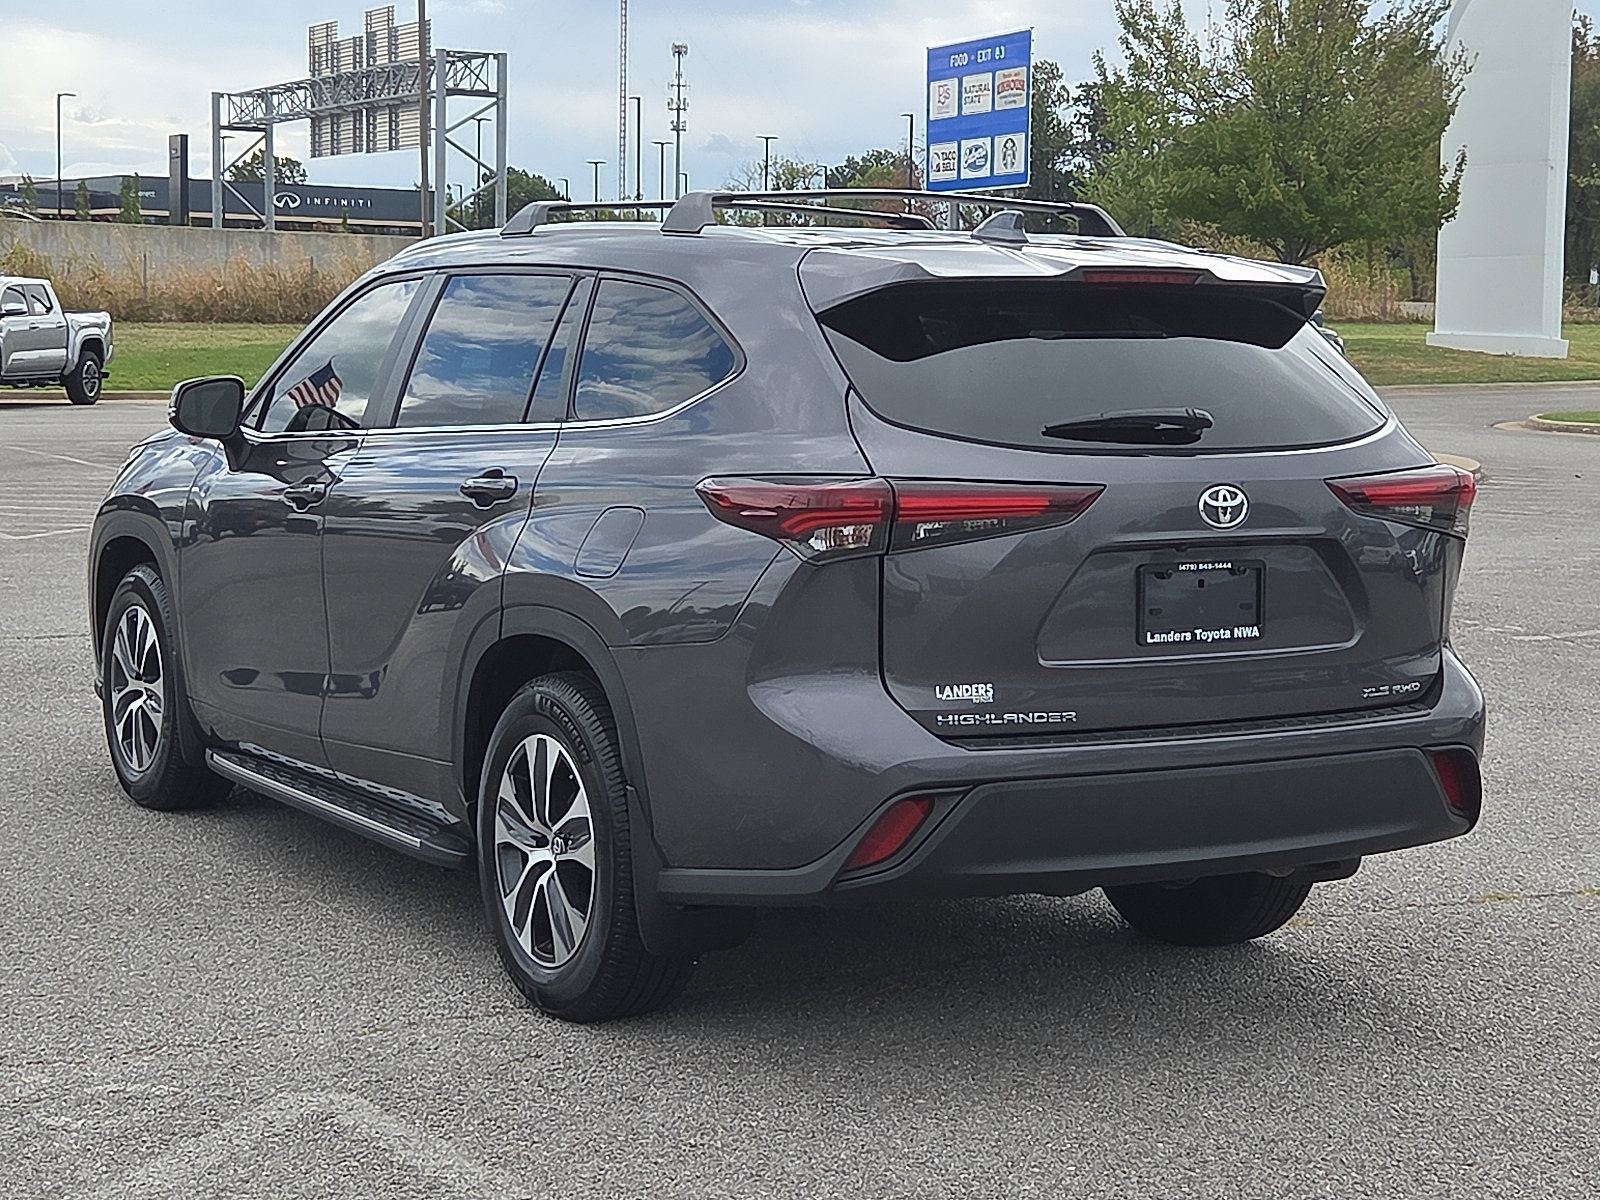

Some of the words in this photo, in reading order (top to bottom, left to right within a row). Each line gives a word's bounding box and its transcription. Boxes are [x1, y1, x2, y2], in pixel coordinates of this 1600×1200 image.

[950, 52, 968, 67] FOOD
[977, 48, 992, 62] EXIT
[963, 82, 991, 95] NATURAL
[963, 94, 982, 106] STATE
[941, 150, 957, 161] TACO
[941, 162, 956, 172] BELL
[306, 196, 372, 208] INFINITI
[1146, 631, 1192, 643] Landers
[1194, 628, 1231, 642] Toyota
[1233, 626, 1260, 638] NWA
[935, 683, 994, 700] LANDERS
[936, 711, 1077, 726] HIGHLANDER
